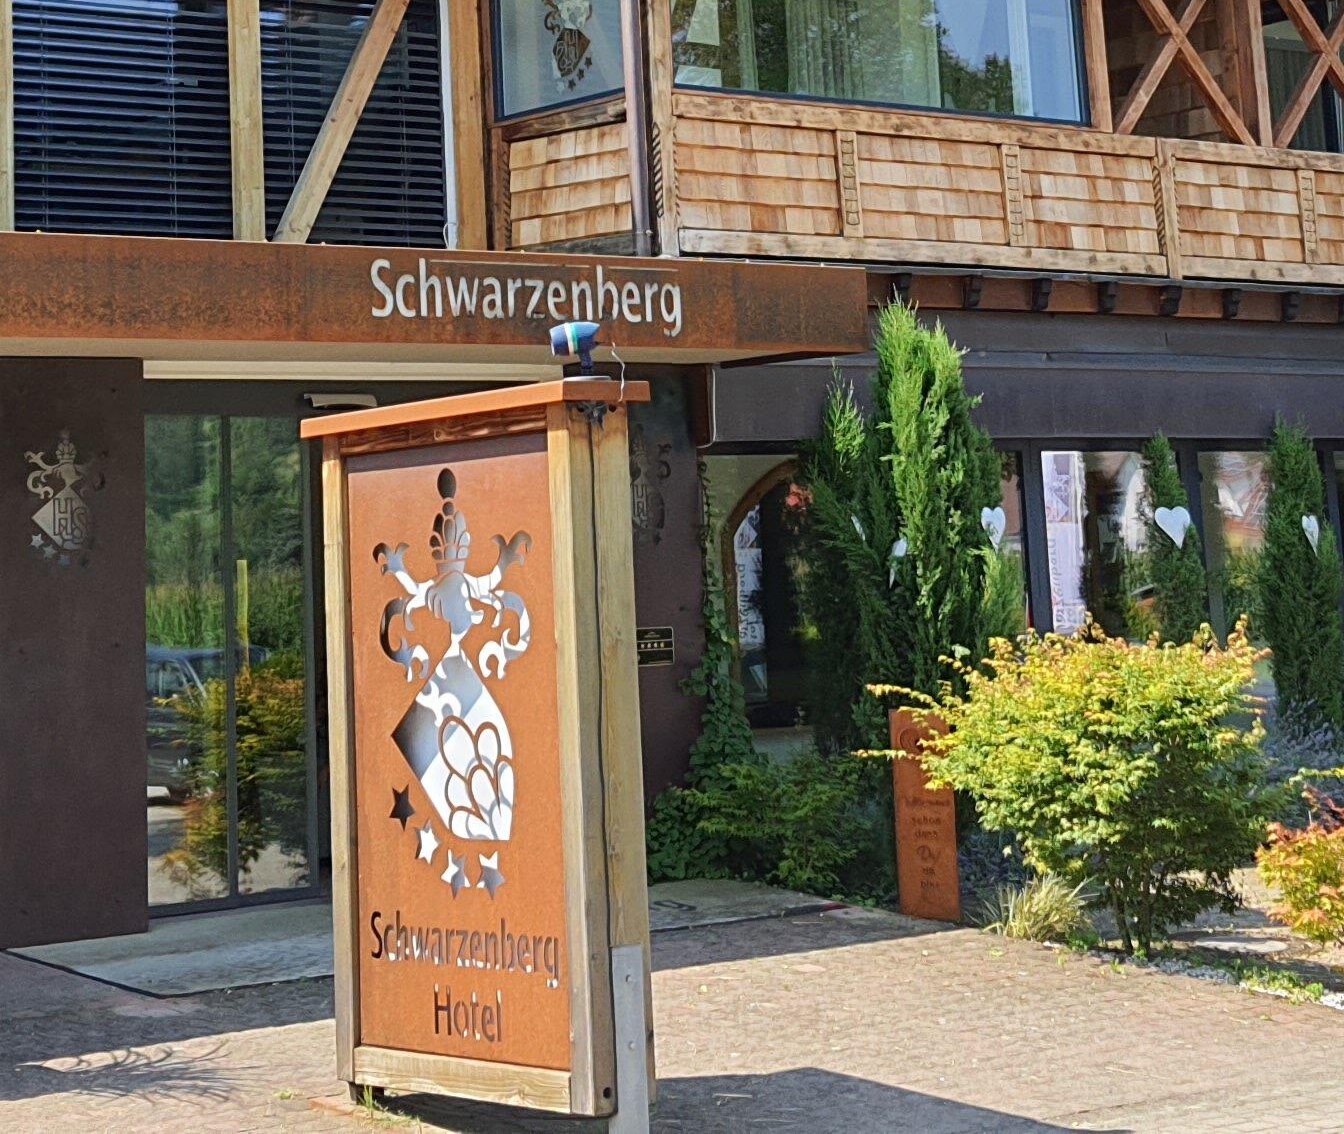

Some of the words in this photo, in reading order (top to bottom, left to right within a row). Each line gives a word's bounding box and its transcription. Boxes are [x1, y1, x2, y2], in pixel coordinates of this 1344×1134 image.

[370, 257, 683, 338] Schwarzenberg
[53, 497, 89, 545] HS
[370, 910, 560, 989] Schwarzenberg
[433, 983, 503, 1043] Hotel
